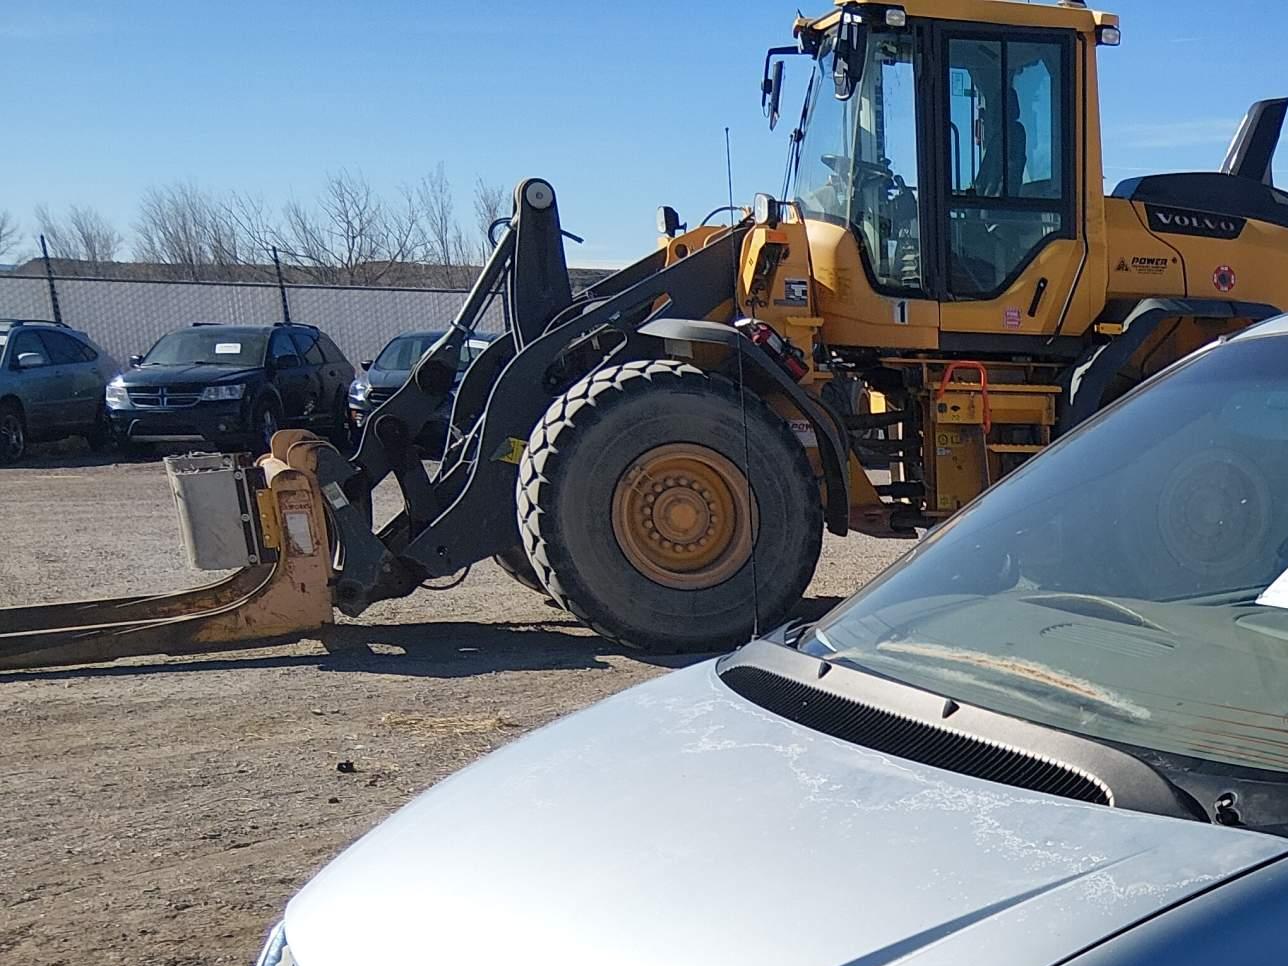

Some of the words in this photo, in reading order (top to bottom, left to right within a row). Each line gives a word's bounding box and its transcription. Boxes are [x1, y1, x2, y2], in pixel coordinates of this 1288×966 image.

[1155, 211, 1236, 232] VOLVO
[1131, 256, 1168, 265] POWER
[897, 300, 906, 323] 1
